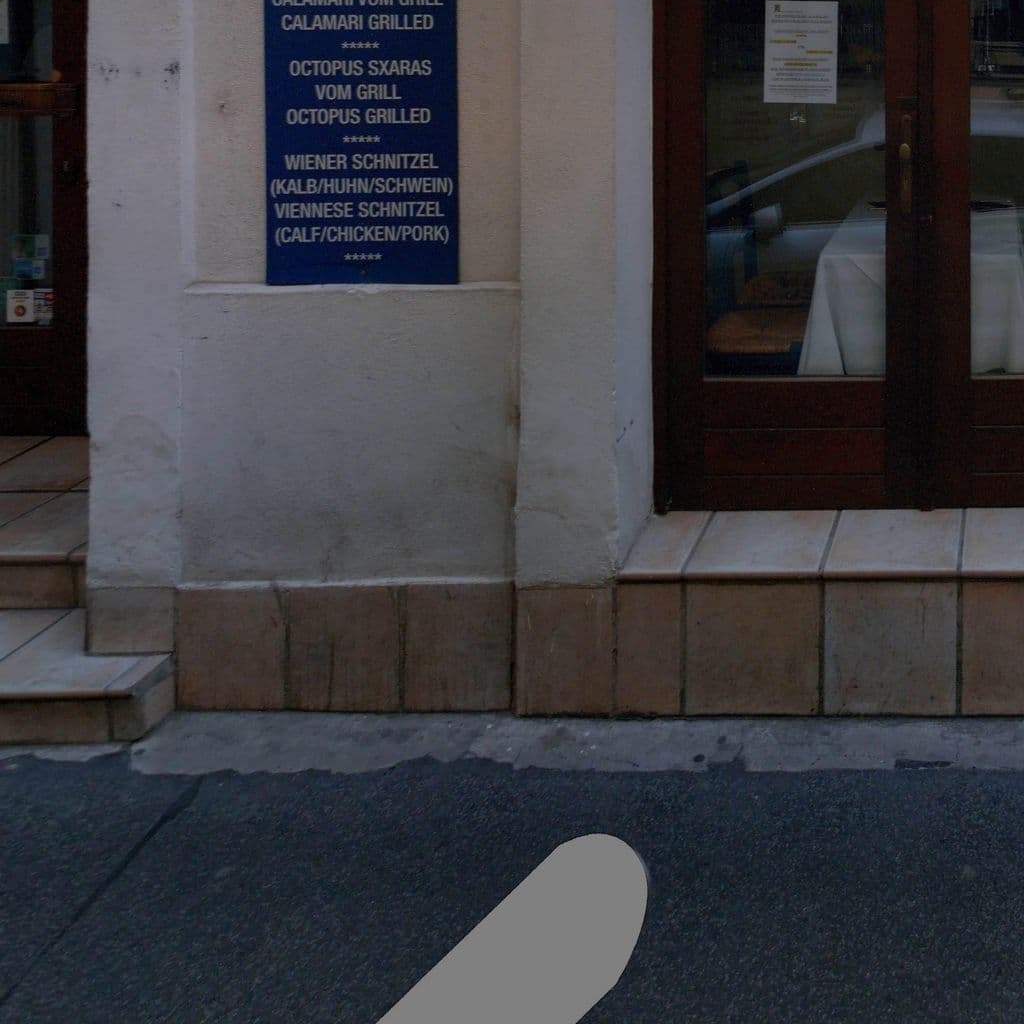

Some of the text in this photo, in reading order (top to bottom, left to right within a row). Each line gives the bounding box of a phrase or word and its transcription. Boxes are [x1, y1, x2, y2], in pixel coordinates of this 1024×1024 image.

[282, 15, 433, 30] CALAMARI GRILLED
[290, 60, 431, 76] OCTOPUS SXARAS
[315, 84, 401, 100] VOM GRILL
[287, 108, 430, 124] OCTOPUS GRILLED
[285, 154, 438, 170] WIENER SCHNITZEL
[270, 178, 453, 197] (KALB/HUHN/SCHWEIN)
[275, 202, 444, 218] VIENNESE SCHNITZEL
[275, 226, 449, 246] (CALF/CHICKEN/PORK)
